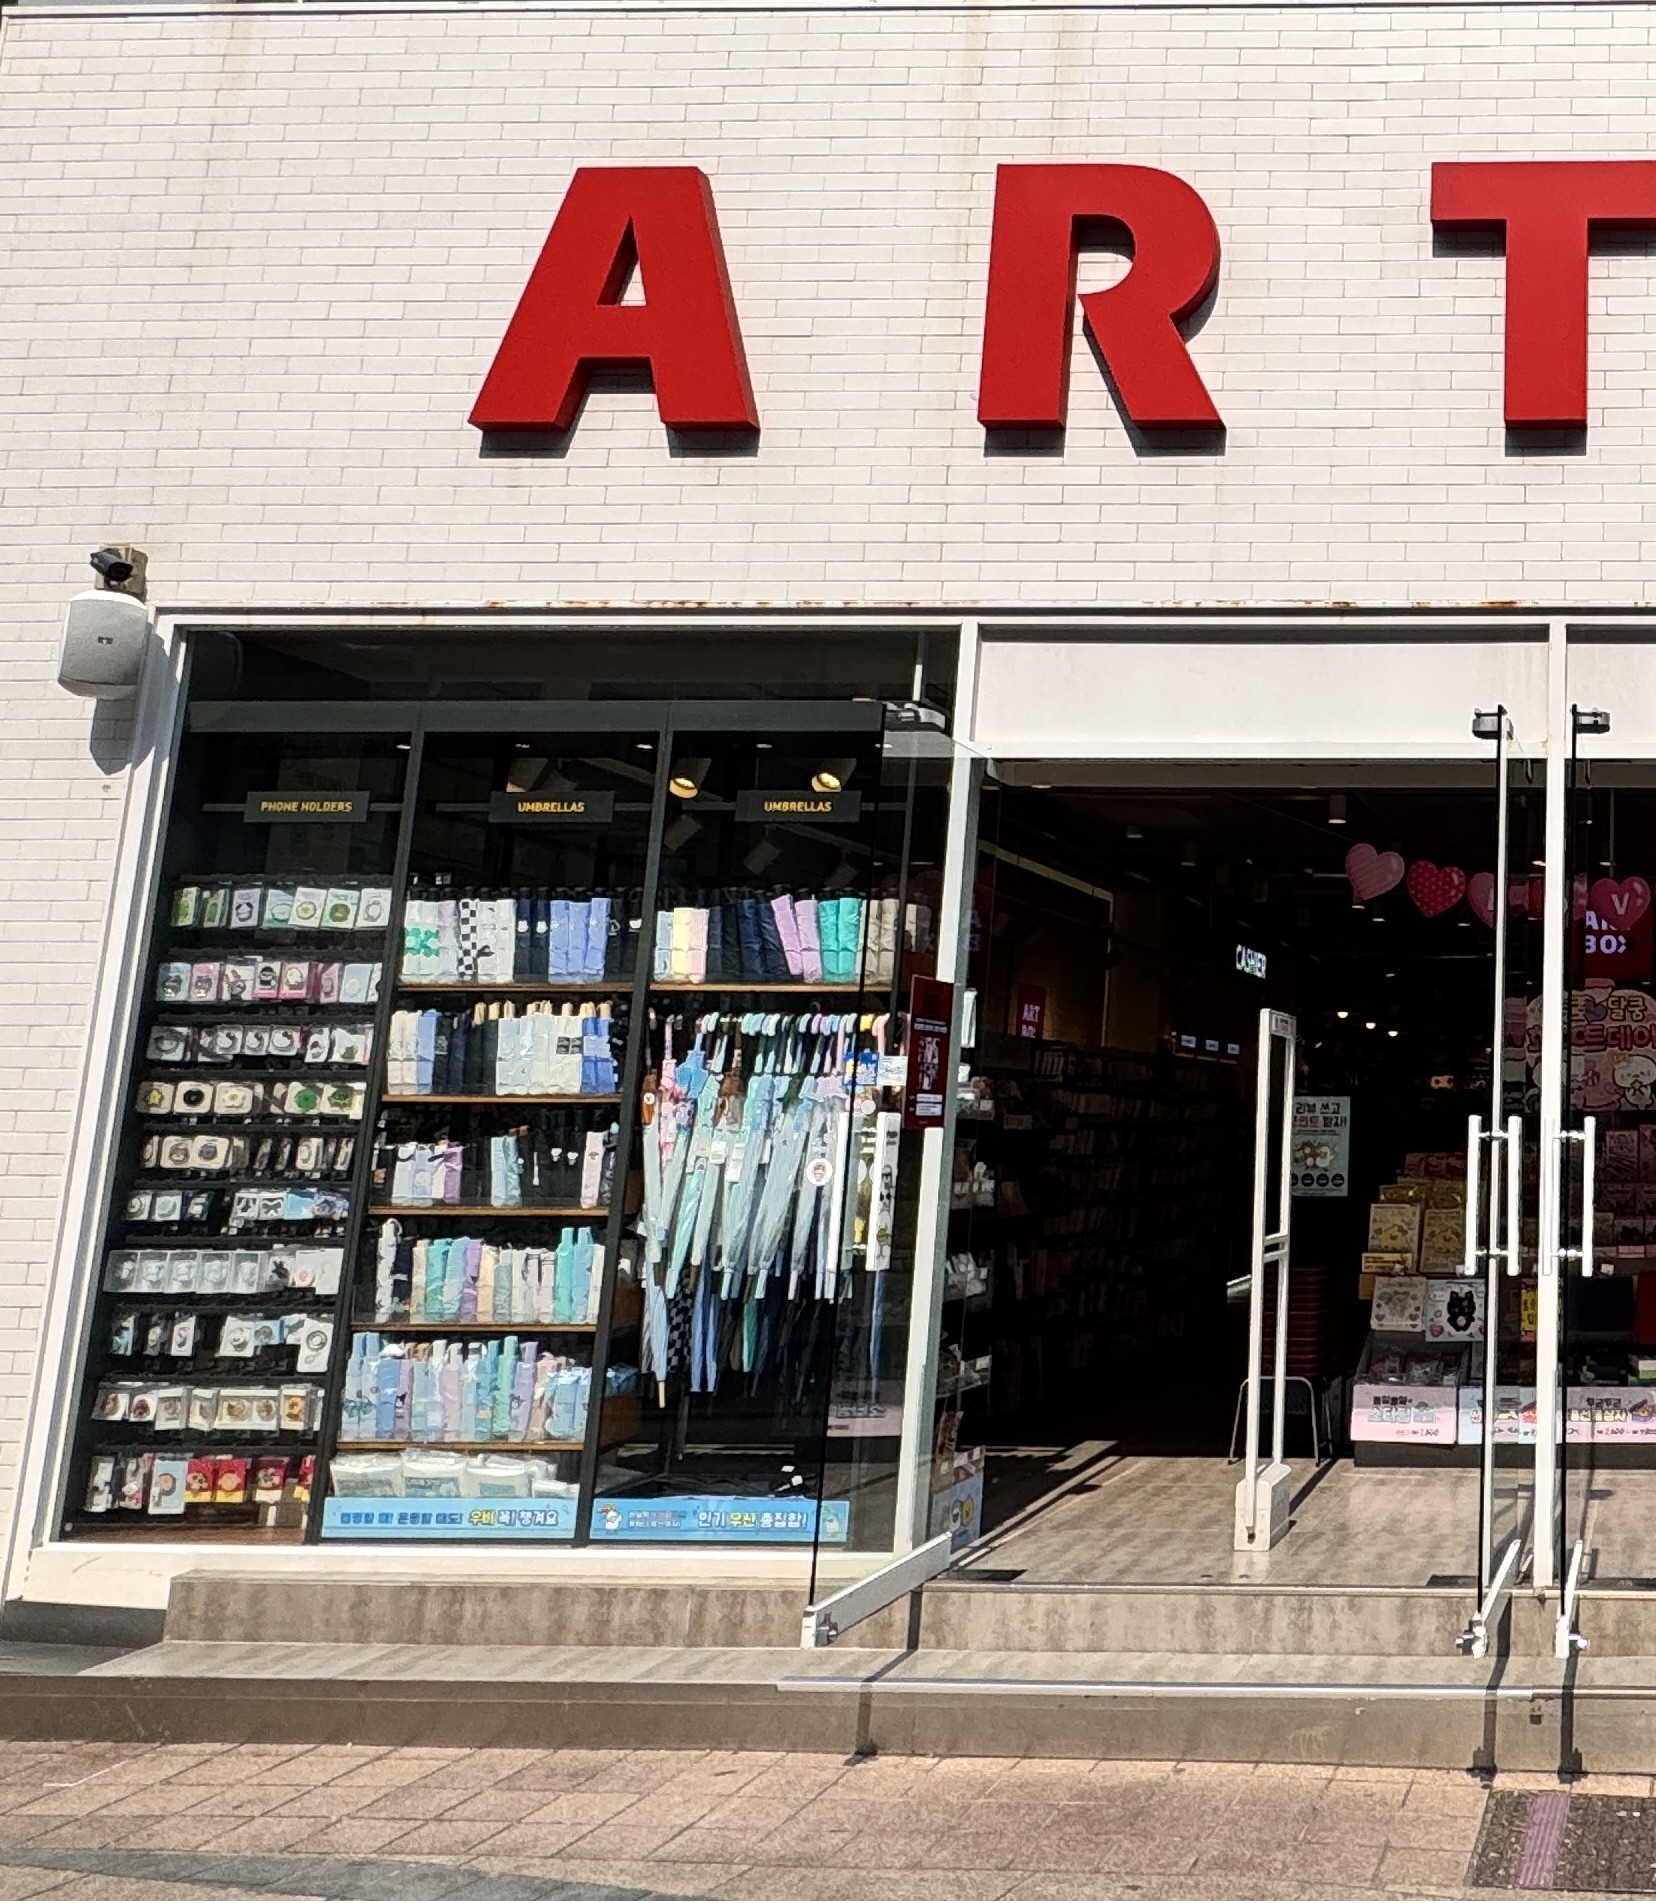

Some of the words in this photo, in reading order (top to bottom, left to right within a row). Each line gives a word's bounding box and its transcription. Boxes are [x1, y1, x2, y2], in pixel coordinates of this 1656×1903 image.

[260, 801, 299, 813] PHONE
[300, 801, 353, 813] HOLDERS
[517, 801, 585, 814] UMBRELLAS
[763, 801, 832, 814] UMBRELLAS
[1295, 1102, 1316, 1114] 리뷰
[1319, 1102, 1341, 1114] 쓰고
[468, 1509, 496, 1527] 우비
[518, 1509, 559, 1527] 챙겨요
[697, 1511, 726, 1528] 인기
[729, 1511, 757, 1528] 우산
